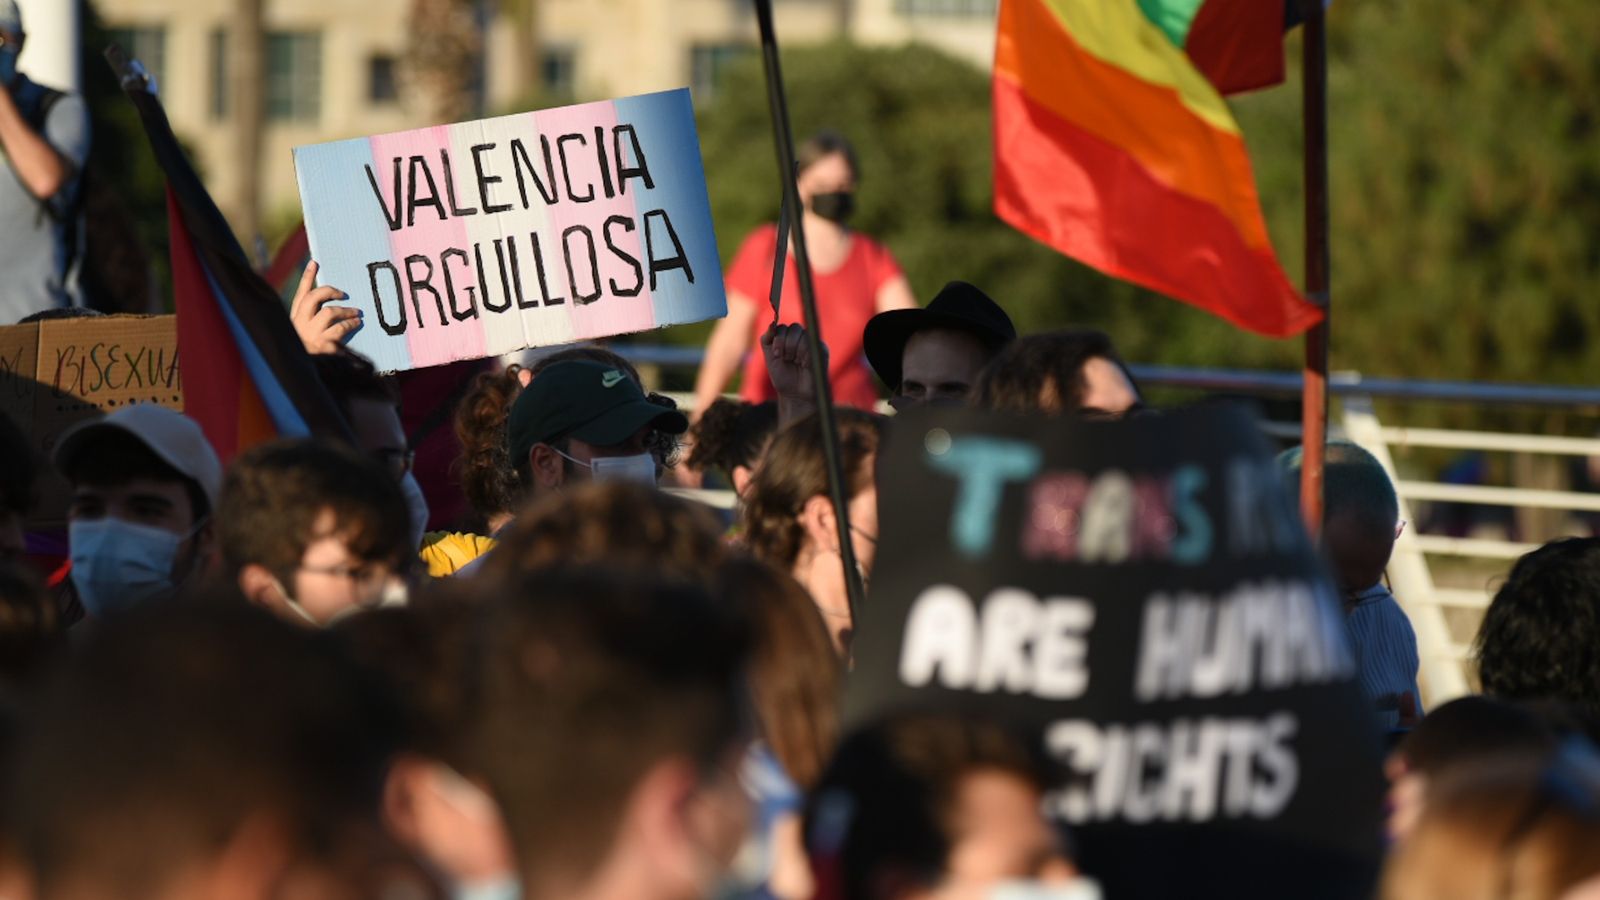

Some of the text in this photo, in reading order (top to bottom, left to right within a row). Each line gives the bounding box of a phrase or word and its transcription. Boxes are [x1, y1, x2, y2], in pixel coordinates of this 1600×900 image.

[365, 123, 655, 231] VALENCIA
[367, 209, 694, 336] ORGULLOSA
[926, 433, 1214, 565] TRANS
[898, 584, 1095, 700] ARE
